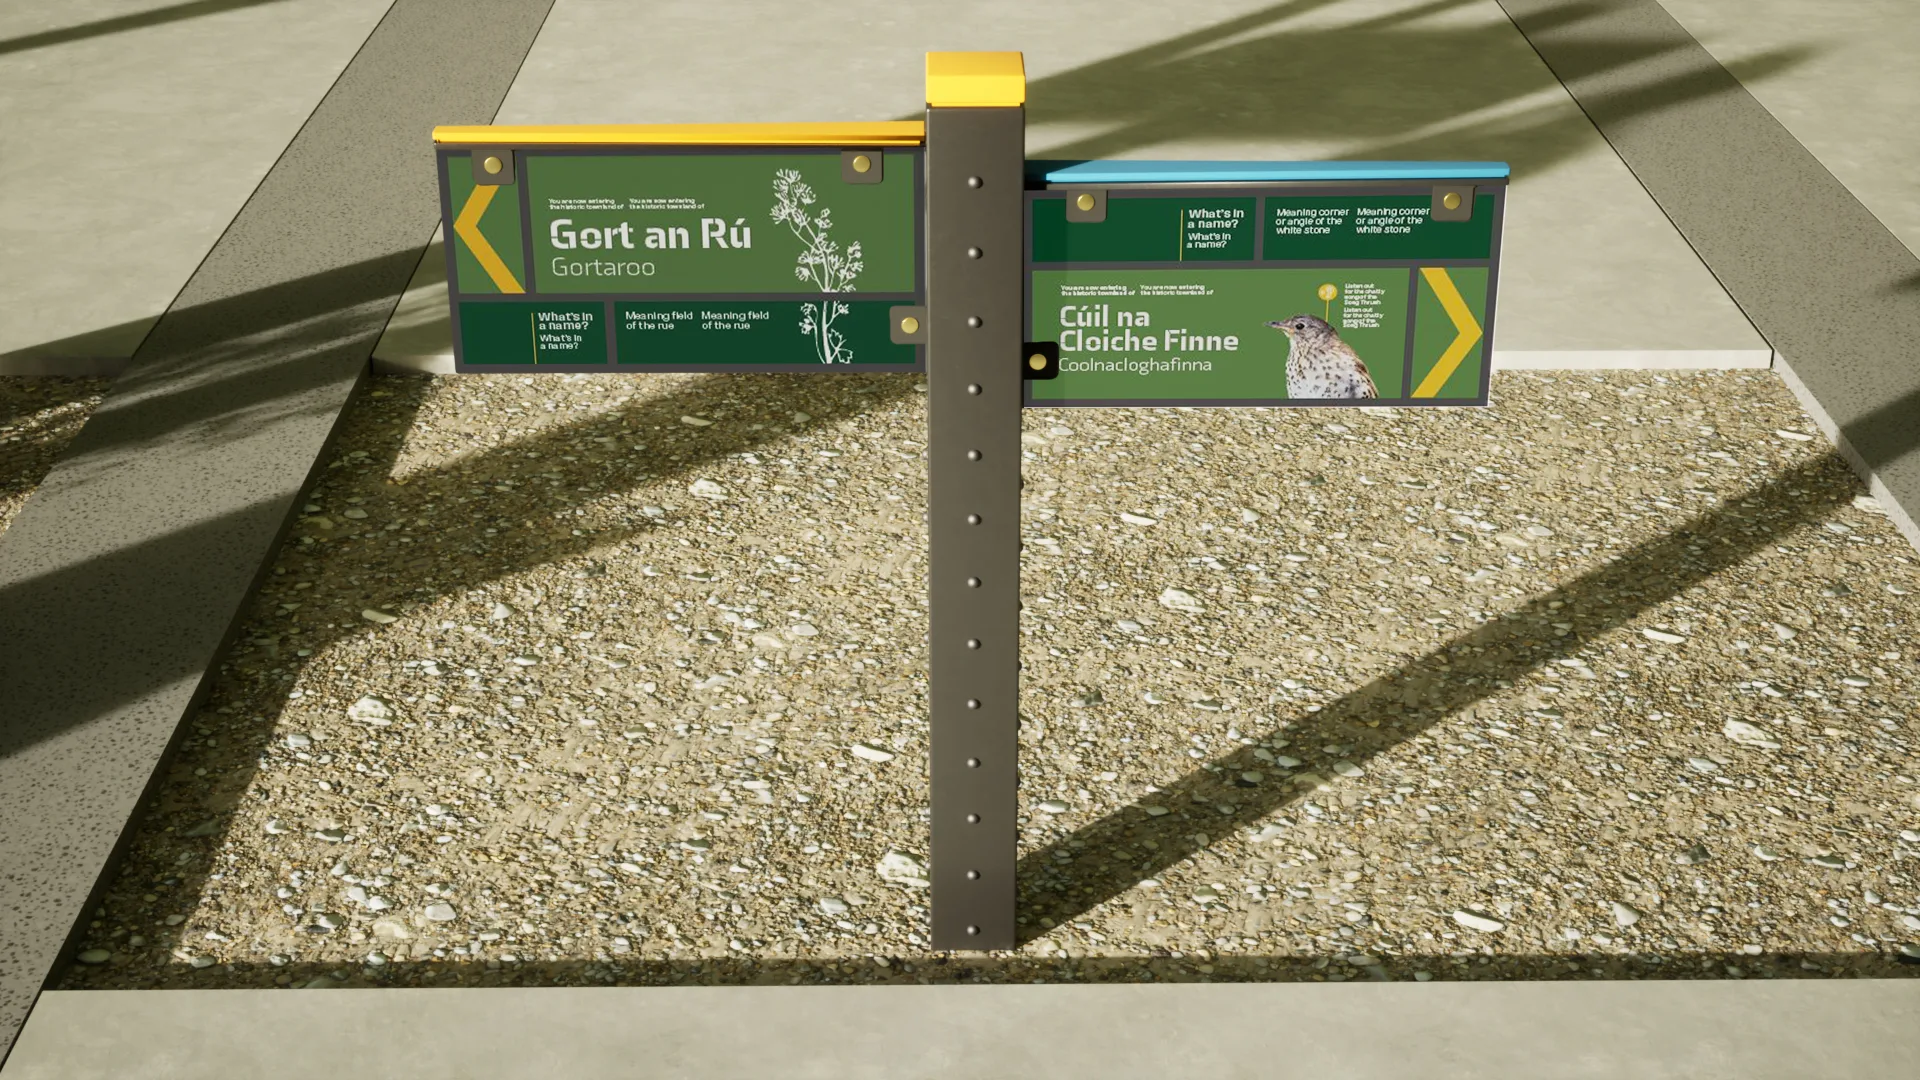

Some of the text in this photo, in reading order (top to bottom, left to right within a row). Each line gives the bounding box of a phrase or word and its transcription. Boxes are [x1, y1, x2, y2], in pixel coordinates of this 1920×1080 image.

[1188, 208, 1244, 218] What's in
[1277, 208, 1316, 218] Meaning
[1357, 208, 1397, 218] Meaning
[1198, 219, 1239, 228] name?
[1287, 217, 1314, 227] angle
[1315, 217, 1325, 225] of
[1327, 217, 1342, 225] the
[1368, 216, 1395, 226] angle
[1395, 216, 1405, 224] of
[1407, 216, 1423, 224] the
[550, 218, 751, 249] Gort an Rú
[1188, 232, 1231, 240] What's in
[552, 257, 655, 276] Gortaroo
[538, 312, 593, 321] What's in
[625, 311, 693, 322] Meaning field
[701, 311, 770, 322] Meaning field
[1060, 304, 1150, 327] Cúil na
[549, 321, 589, 330] name?
[626, 321, 637, 330] of
[639, 321, 655, 330] the
[702, 321, 714, 330] of
[714, 321, 731, 330] the
[1060, 328, 1239, 351] Cloiche Finne
[548, 342, 579, 350] name?
[1059, 358, 1212, 375] Coolnacloghafinna
